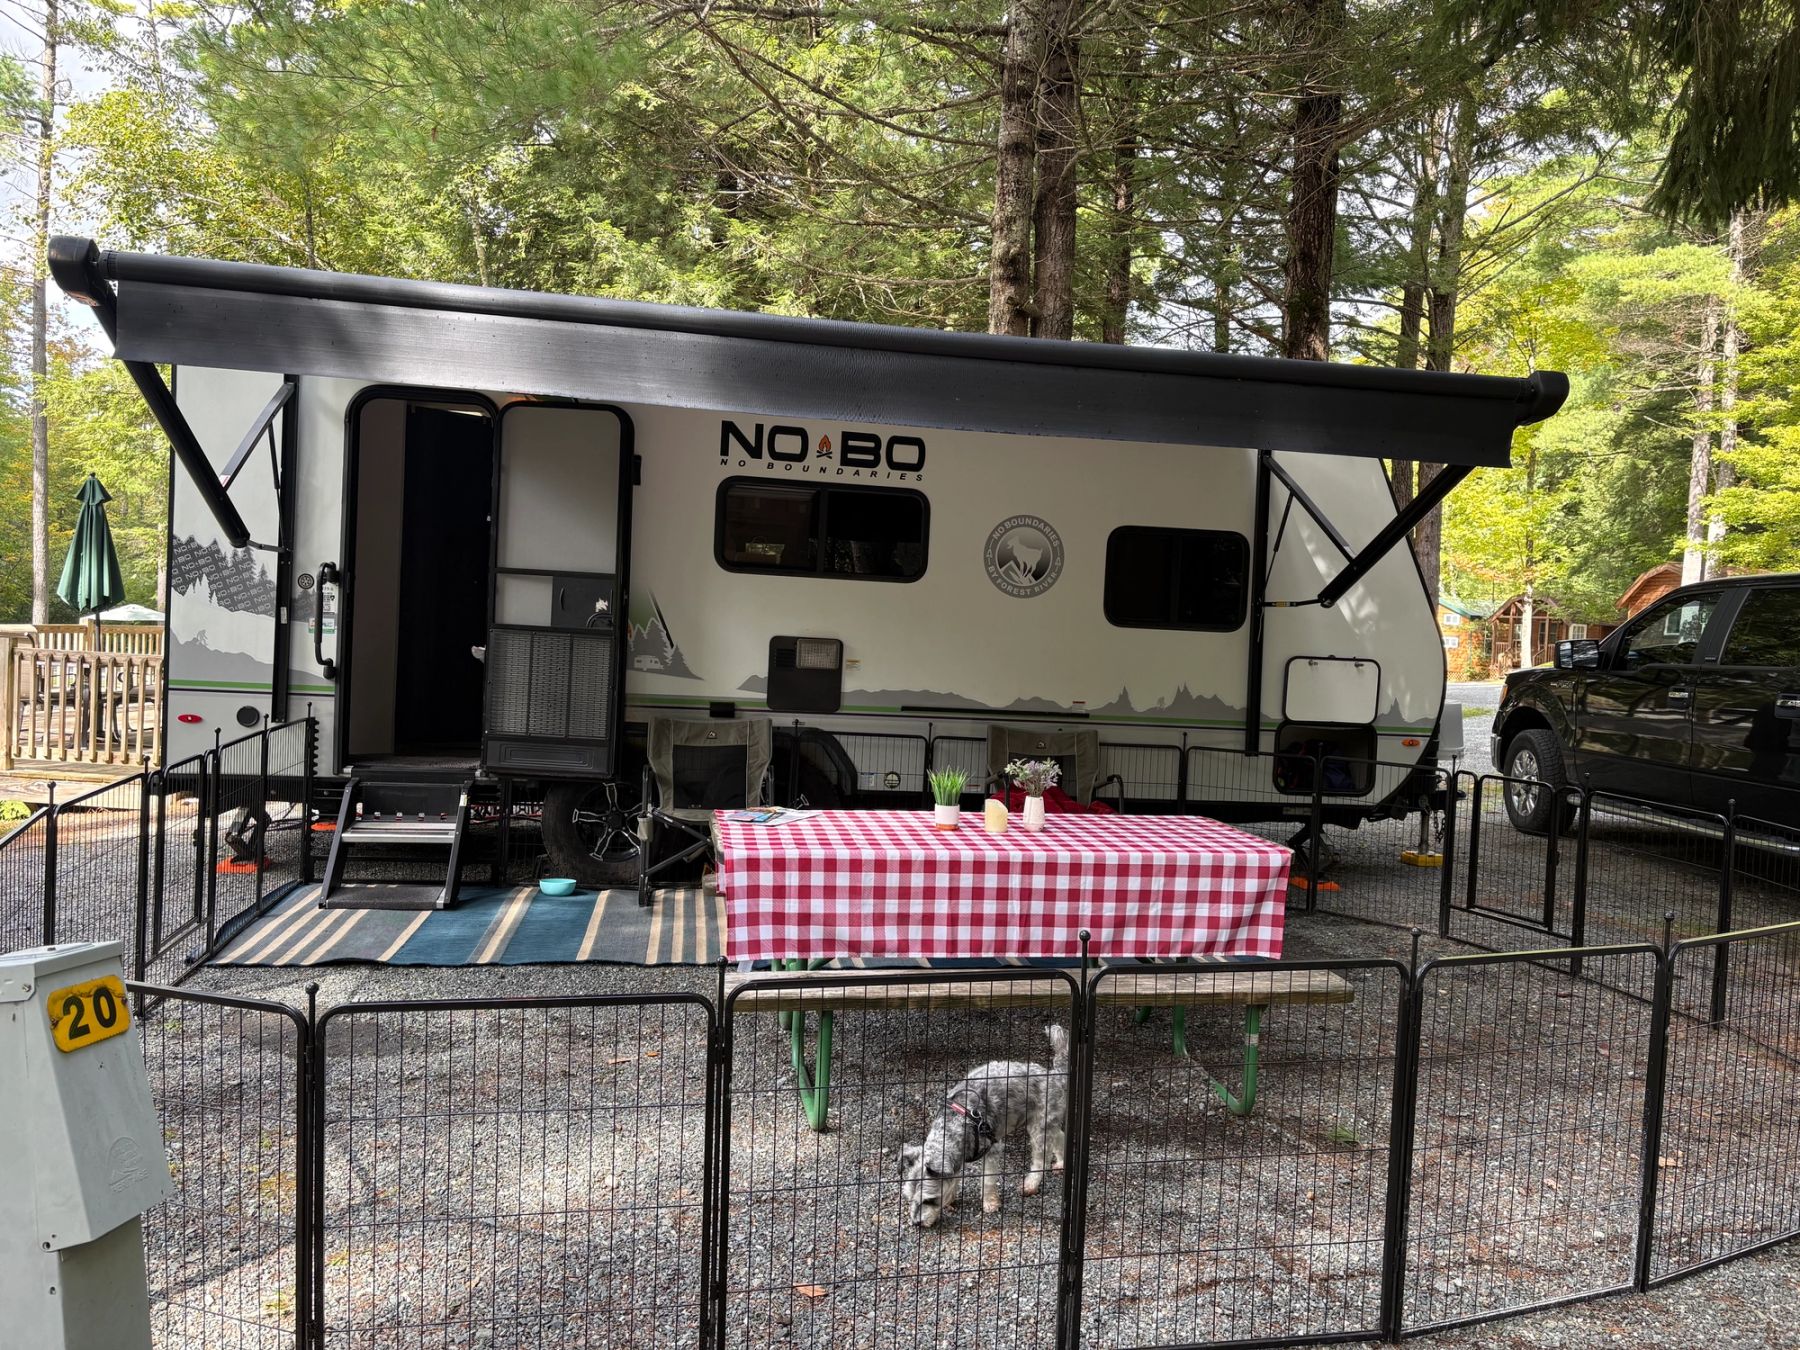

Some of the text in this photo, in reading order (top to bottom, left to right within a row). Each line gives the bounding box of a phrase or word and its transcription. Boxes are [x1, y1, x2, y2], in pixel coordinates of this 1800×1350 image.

[720, 459, 923, 482] NO BOUNDARIES
[993, 517, 1060, 547] NO BOUNDARIES
[996, 578, 1032, 595] FOREST
[1034, 571, 1057, 592] RIVER
[62, 986, 117, 1040] 20
